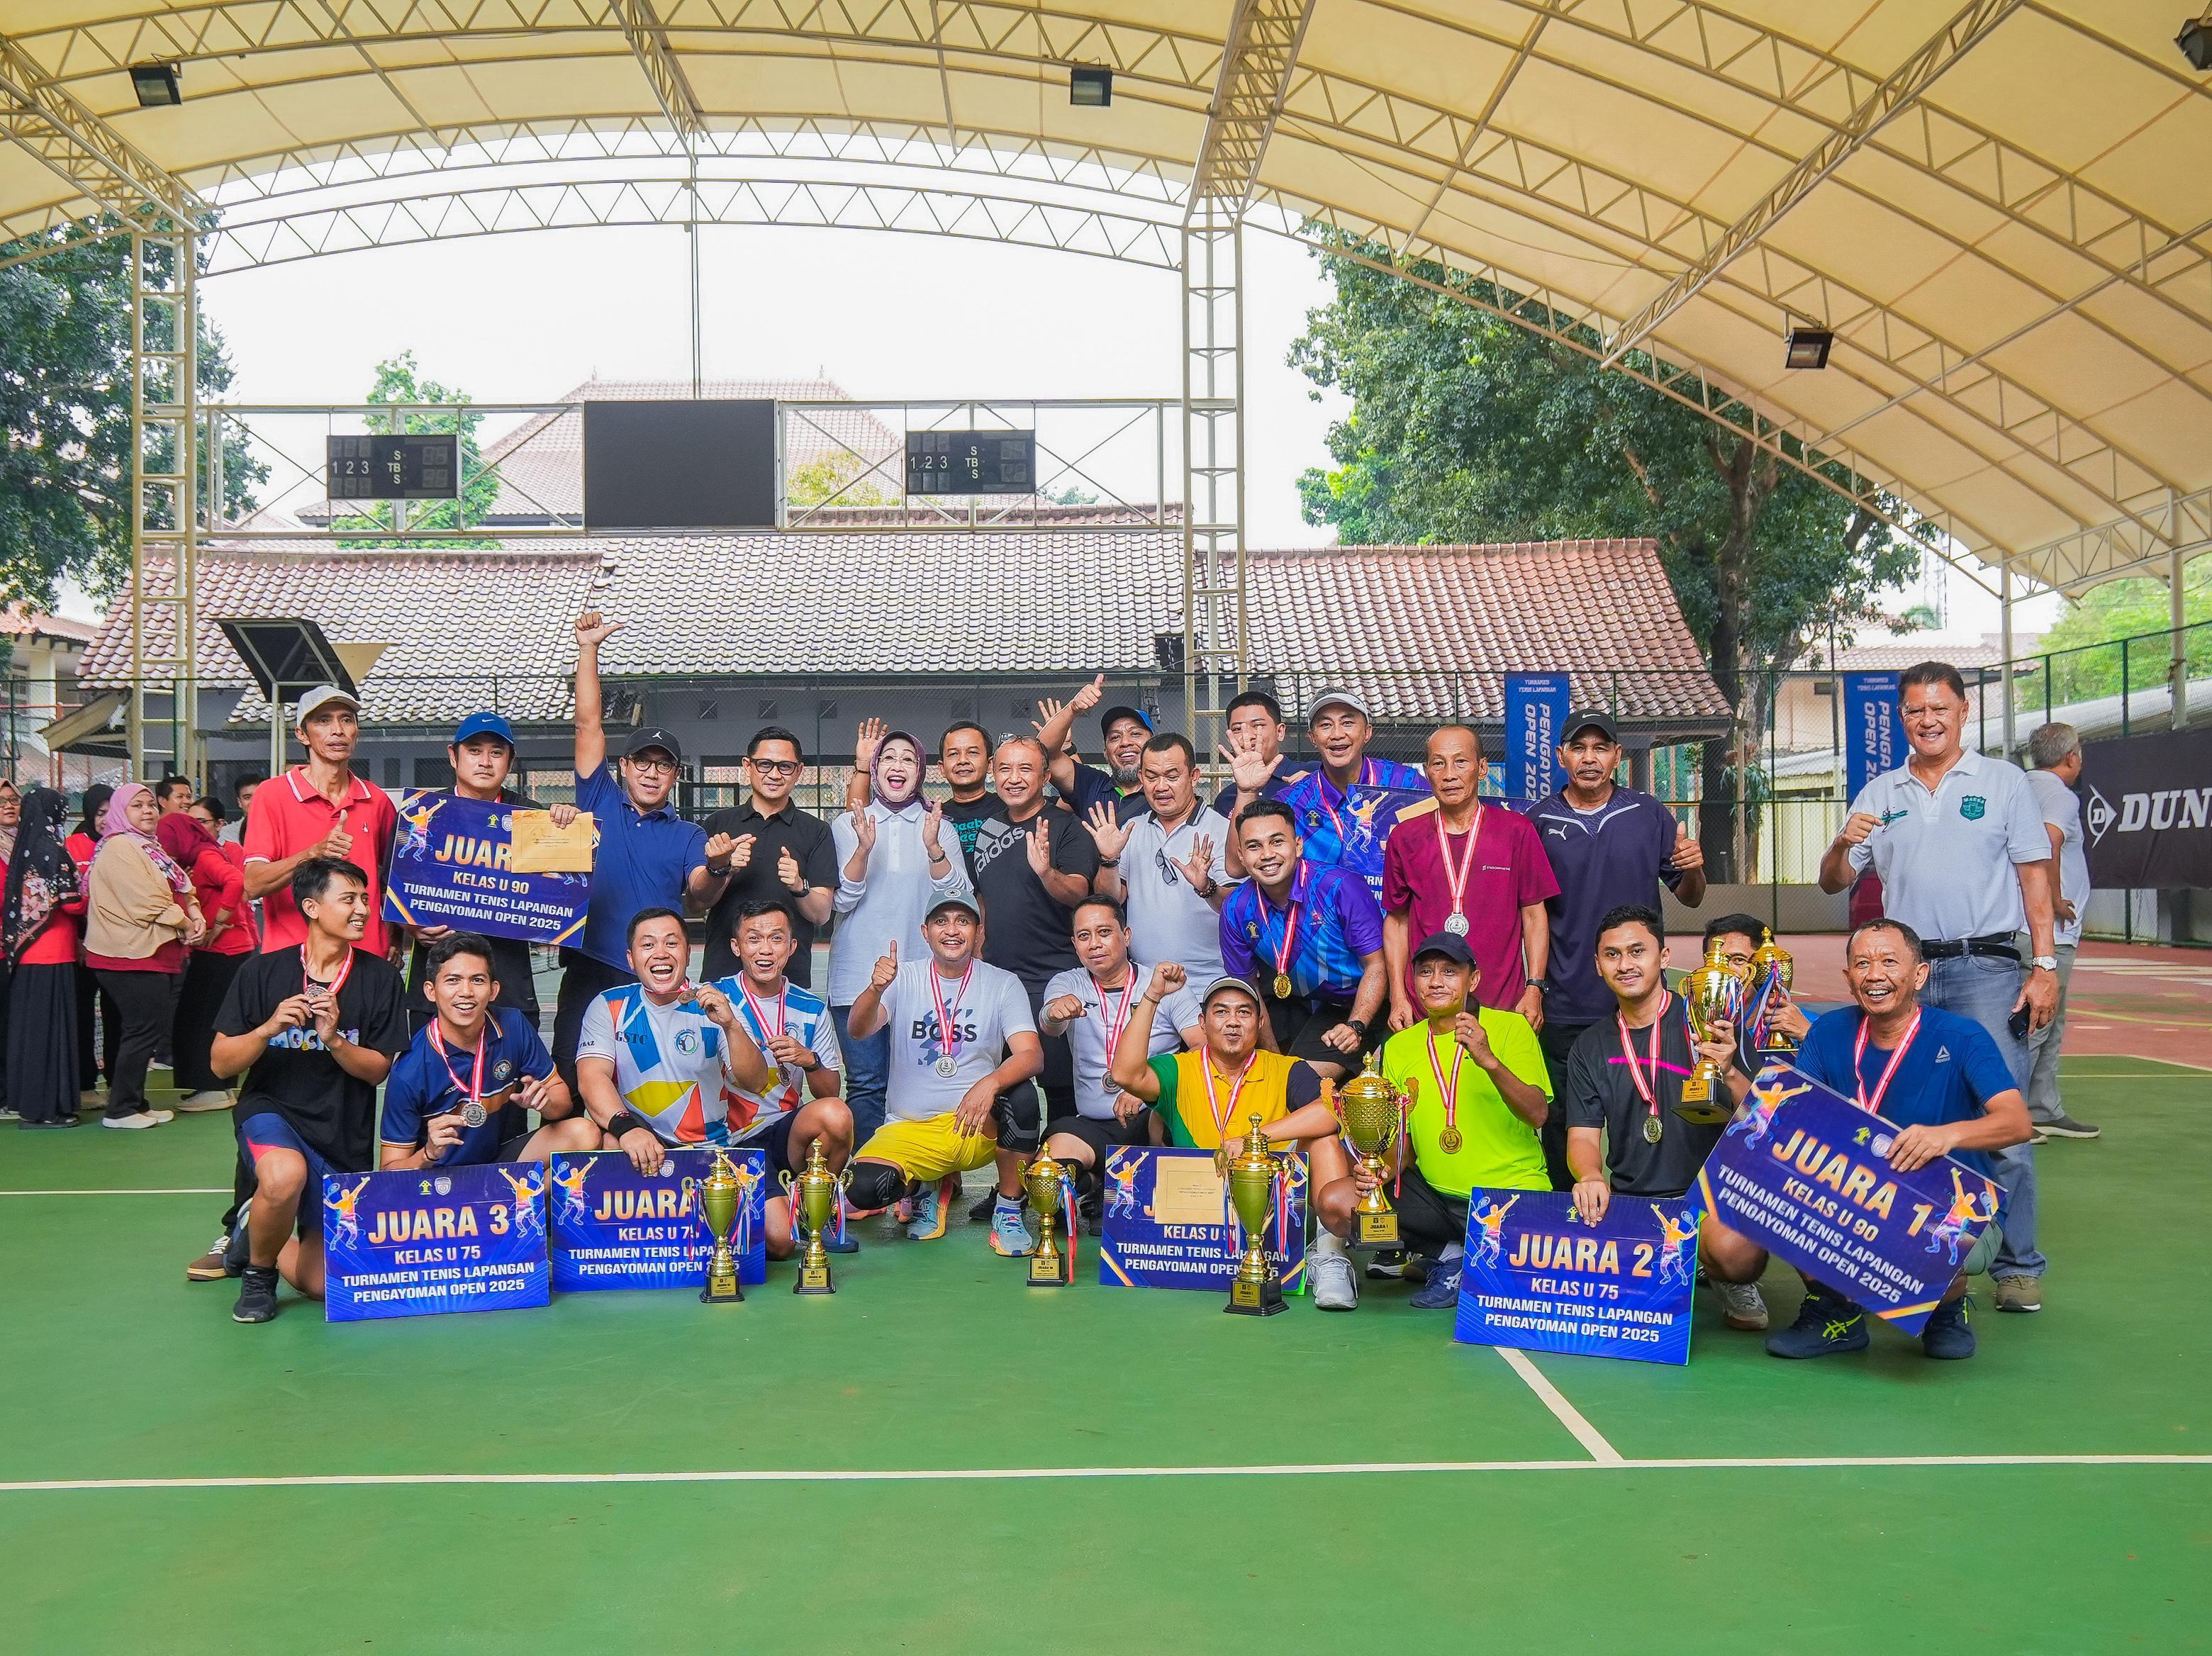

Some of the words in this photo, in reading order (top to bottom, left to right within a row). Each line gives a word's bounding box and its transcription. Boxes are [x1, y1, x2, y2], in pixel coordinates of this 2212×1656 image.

[394, 450, 401, 461] S
[910, 456, 916, 470] 1
[925, 456, 932, 469] 2
[940, 455, 948, 469] 3
[965, 457, 978, 467] TB
[971, 446, 978, 456] S
[331, 461, 338, 474] 1
[345, 461, 354, 475] 2
[361, 461, 369, 474] 3
[386, 462, 401, 473] TB
[393, 474, 401, 484] S
[971, 469, 978, 479] S
[1525, 703, 1536, 758] OPEN
[1865, 702, 1877, 756] OPEN
[1879, 700, 1892, 773] PENGA
[1539, 703, 1551, 800] PENGAYO
[1525, 762, 1536, 799] 202
[2117, 787, 2212, 832] DUN
[435, 834, 511, 871] JUAR
[453, 871, 496, 890] KELAS
[499, 880, 508, 891] U
[511, 881, 530, 895] 90
[403, 883, 470, 902] TURNAMEN
[474, 893, 508, 908] TENIS
[510, 900, 573, 918] LAPANGAN
[410, 899, 493, 920] PENGAYOMAN
[496, 912, 527, 926] OPEN
[529, 917, 562, 931] 2025
[1772, 1128, 1900, 1221] JUARA
[1906, 1204, 1933, 1238] 1
[1782, 1176, 1839, 1216] KELAS
[1838, 1206, 1852, 1226] U
[1853, 1216, 1879, 1242] 90
[368, 1206, 479, 1245] JUARA
[488, 1204, 510, 1235] 3
[618, 1226, 664, 1241] KELAS
[668, 1226, 677, 1239] U
[1163, 1225, 1207, 1241] KELAS
[1210, 1228, 1219, 1241] U
[1717, 1164, 1802, 1221] TURNAMEN
[1801, 1212, 1843, 1247] TENIS
[1843, 1238, 1925, 1296] LAPANGAN
[395, 1248, 444, 1265] KELAS
[447, 1247, 457, 1261] U
[462, 1246, 481, 1260] 75
[569, 1248, 639, 1260] TURNAMEN
[643, 1246, 680, 1259] TENIS
[1116, 1242, 1183, 1257] TURNAMEN
[1185, 1246, 1222, 1258] TENIS
[1509, 1233, 1620, 1275] JUARA
[1631, 1243, 1655, 1277] 2
[1717, 1186, 1818, 1253] PENGAYOMAN
[1817, 1246, 1860, 1279] OPEN
[1858, 1271, 1903, 1304] 2025
[342, 1271, 419, 1287] TURNAMEN
[422, 1268, 461, 1282] TENIS
[464, 1262, 535, 1279] LAPANGAN
[579, 1262, 666, 1275] PENGAYOMAN
[669, 1261, 703, 1272] OPEN
[1125, 1258, 1206, 1274] PENGAYOMAN
[354, 1285, 447, 1303] PENGAYOMAN
[450, 1282, 486, 1296] OPEN
[489, 1279, 525, 1292] 2025
[1531, 1277, 1580, 1296] KELAS
[1583, 1284, 1594, 1298] U
[1599, 1284, 1619, 1299] 75
[1477, 1294, 1551, 1314] TURNAMEN
[1555, 1302, 1594, 1319] TENIS
[1598, 1306, 1672, 1326] LAPANGAN
[1485, 1314, 1577, 1334] PENGAYOMAN
[1581, 1322, 1617, 1338] OPEN
[1621, 1327, 1660, 1342] 2025
